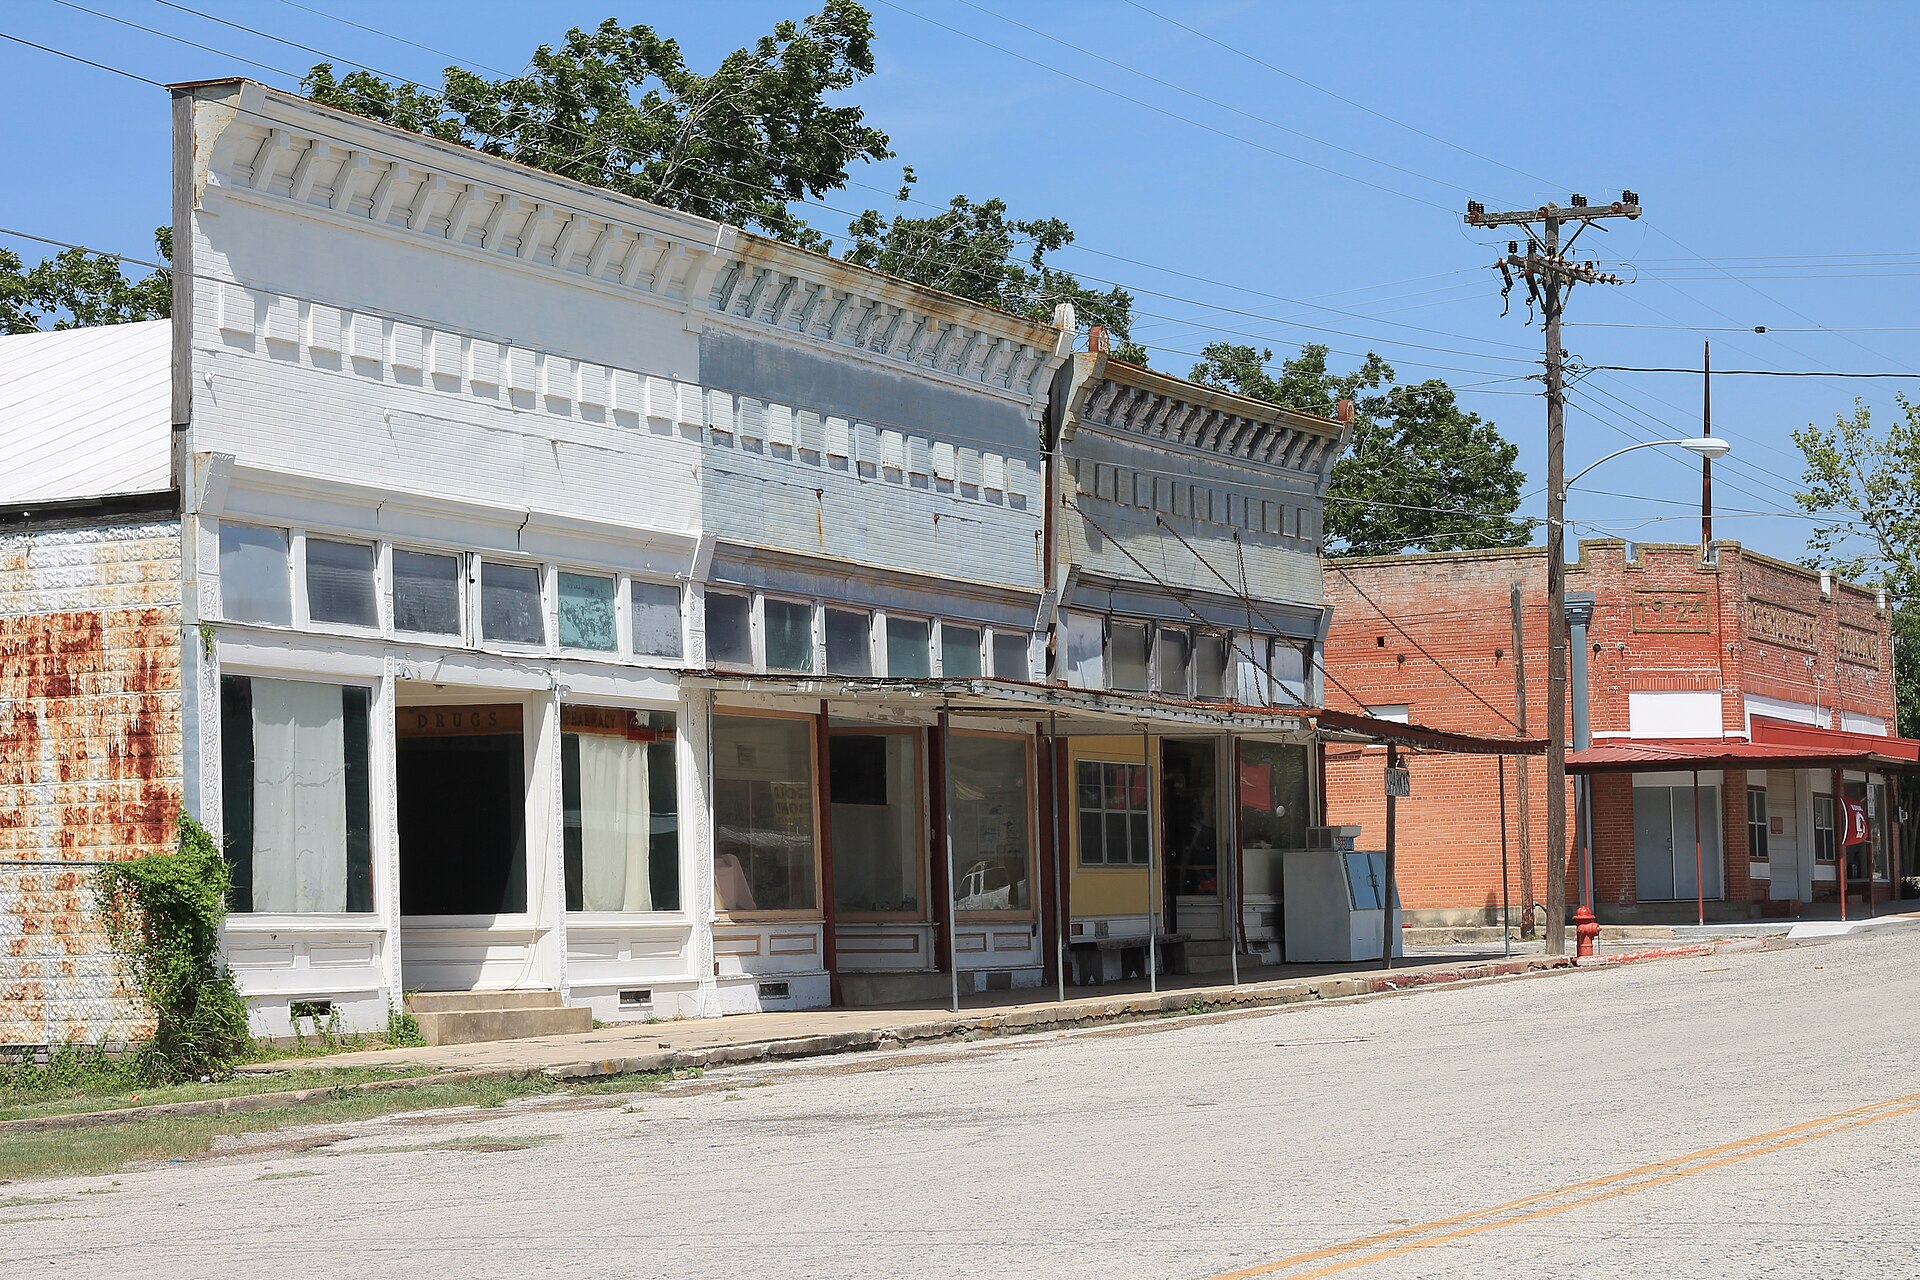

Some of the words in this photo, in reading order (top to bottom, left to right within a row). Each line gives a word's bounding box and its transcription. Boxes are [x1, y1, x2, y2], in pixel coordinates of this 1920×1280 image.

[1638, 599, 1703, 621] 1924
[417, 712, 497, 729] DRUGS
[565, 711, 616, 729] PHARMACY
